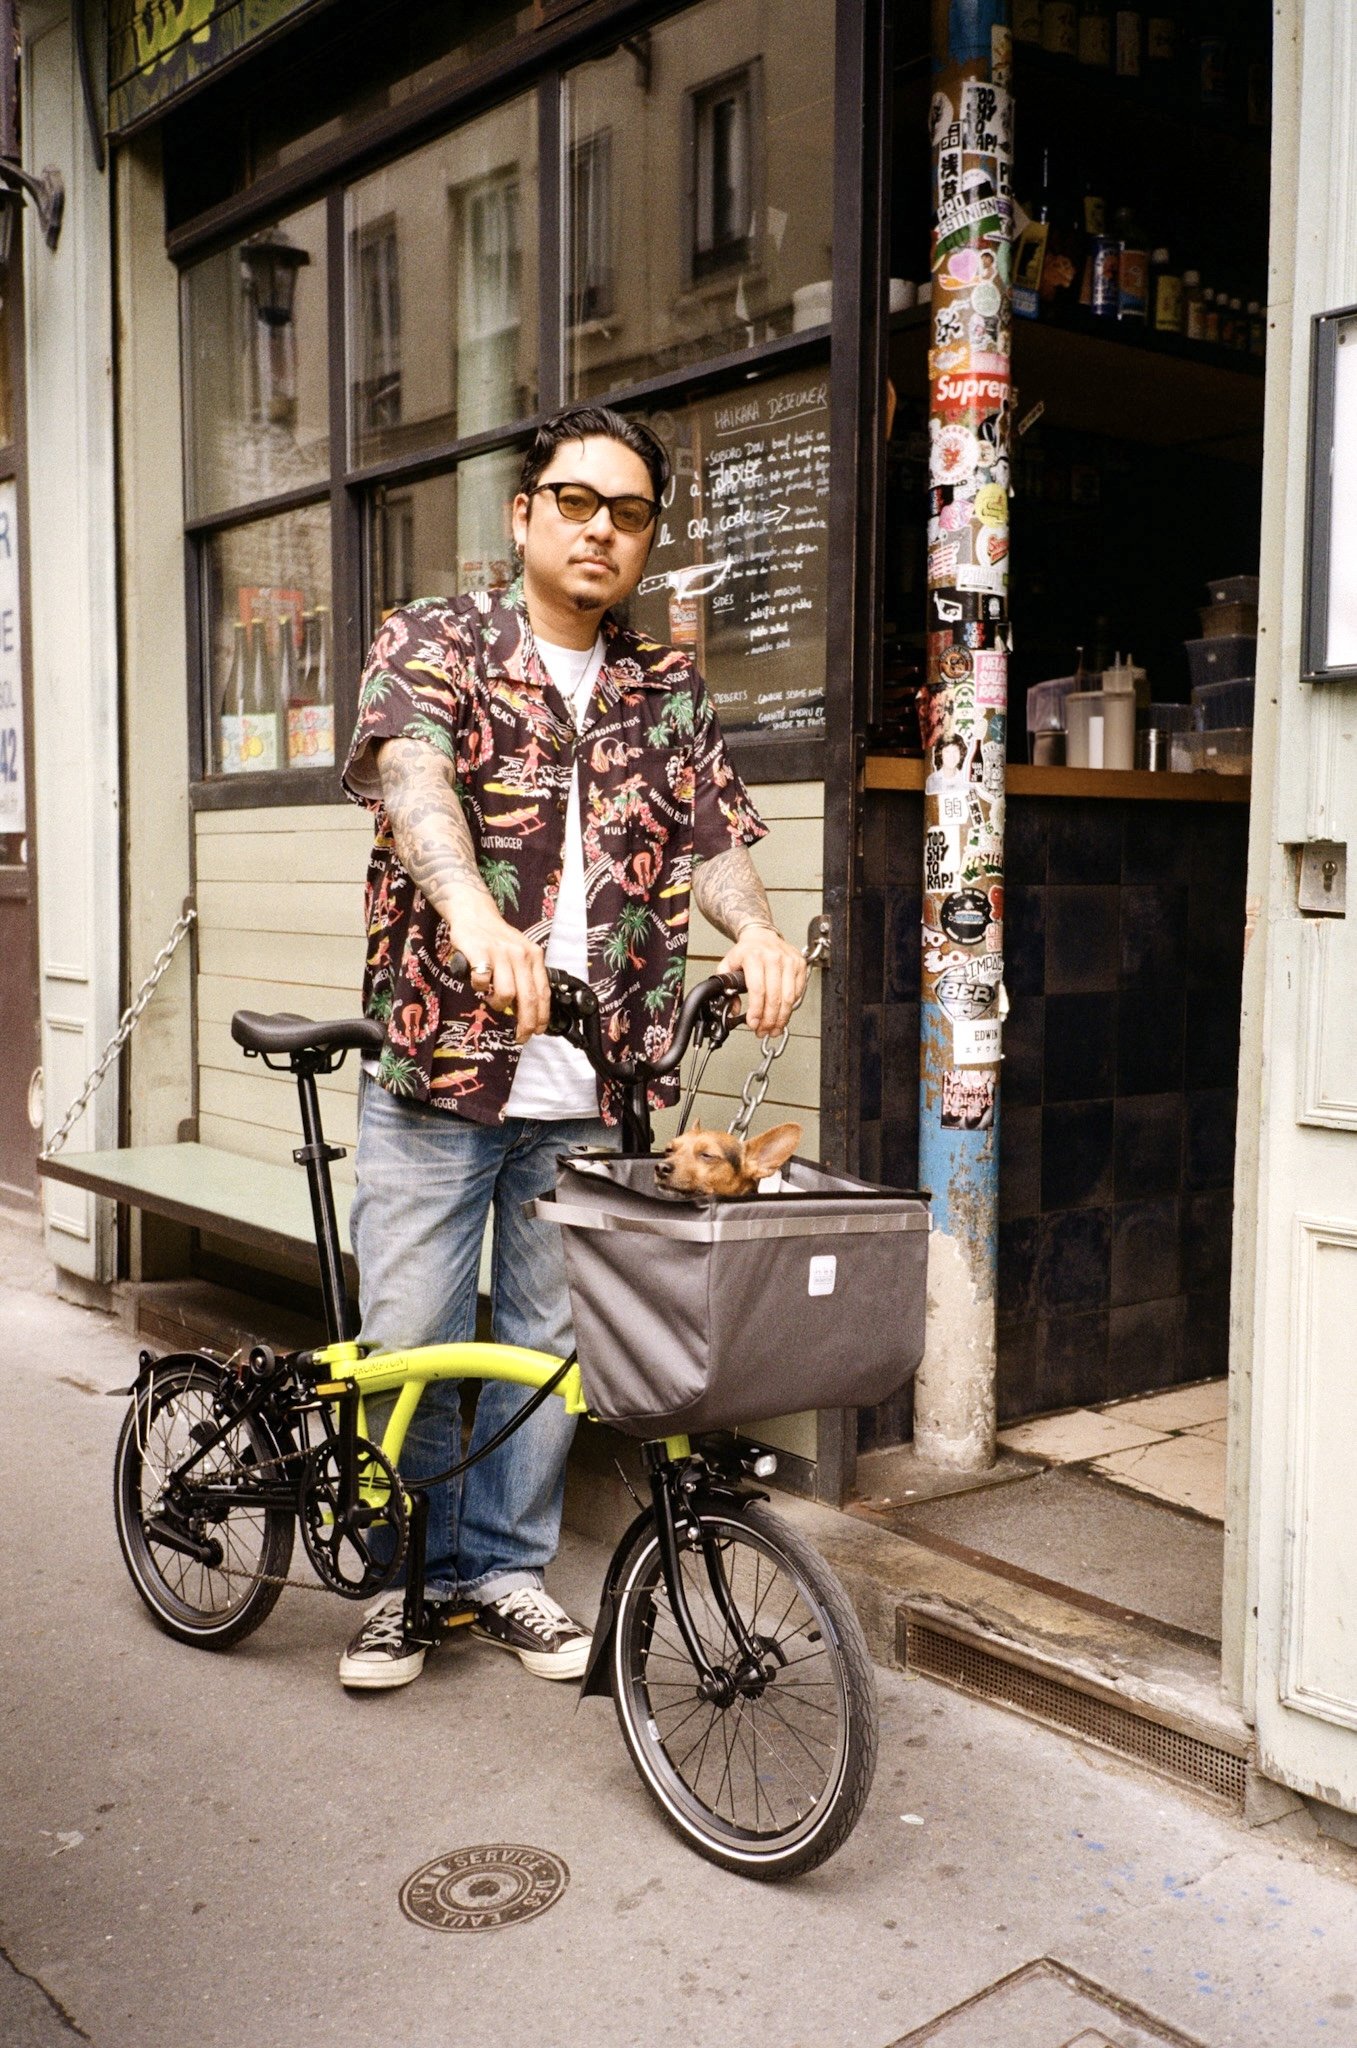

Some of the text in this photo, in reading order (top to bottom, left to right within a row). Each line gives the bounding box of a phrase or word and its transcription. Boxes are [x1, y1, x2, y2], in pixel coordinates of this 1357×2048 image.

[687, 516, 712, 540] QR
[719, 504, 754, 532] code
[711, 593, 735, 609] SIDES
[490, 703, 517, 729] BEACH
[603, 826, 628, 836] HULA
[926, 830, 946, 846] TOO
[480, 835, 523, 851] OUTRIGGER
[926, 844, 949, 863] SHY
[926, 861, 940, 876] TO
[926, 872, 954, 891] RAP!
[439, 972, 465, 994] BEACH
[941, 1103, 982, 1118] Peaks
[438, 1849, 556, 1928] SERVICE DES EAUX
